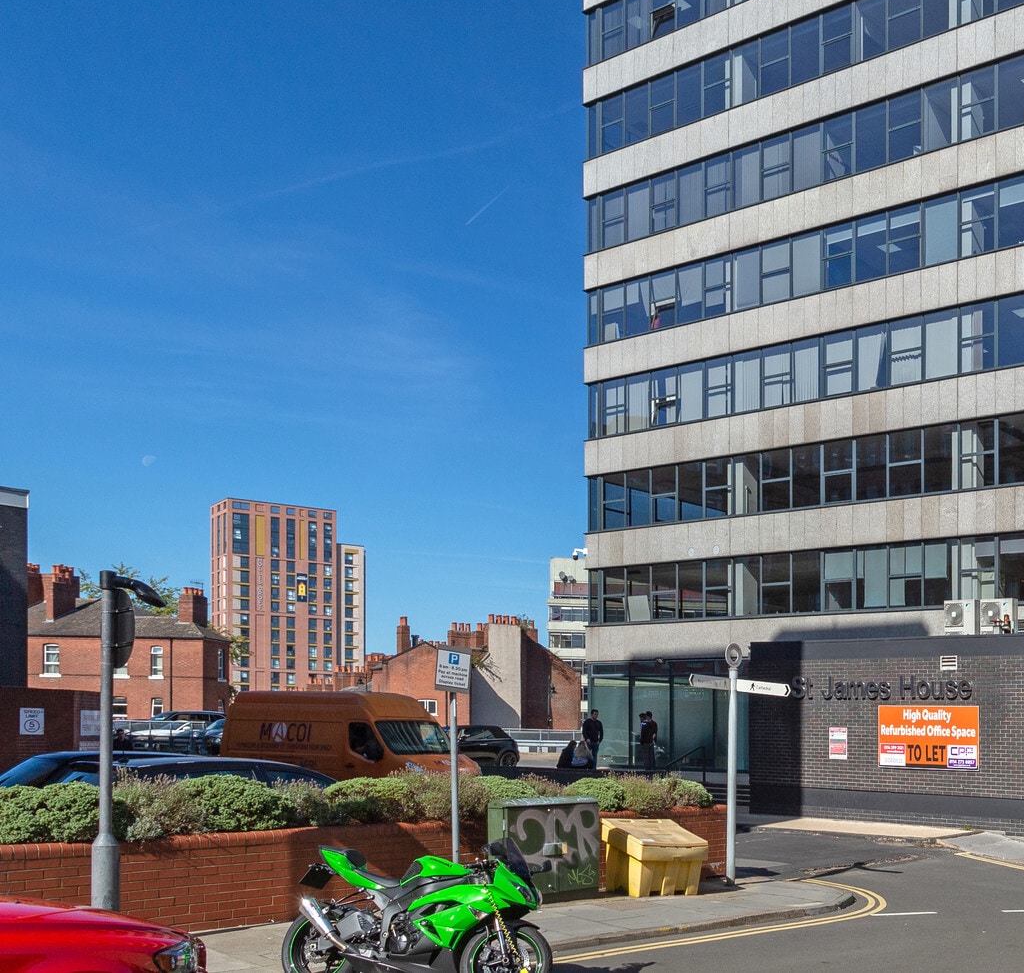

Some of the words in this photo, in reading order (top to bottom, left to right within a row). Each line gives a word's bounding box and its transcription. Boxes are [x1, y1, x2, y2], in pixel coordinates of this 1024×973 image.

[791, 675, 813, 700] St
[821, 675, 891, 700] James
[899, 675, 972, 700] House
[903, 709, 920, 723] High
[922, 709, 952, 723] Quality
[260, 722, 312, 743] MACOI
[881, 724, 926, 736] Refurbished
[926, 725, 950, 737] Office
[951, 725, 976, 739] Space
[907, 744, 922, 762] TO
[925, 745, 946, 762] LET
